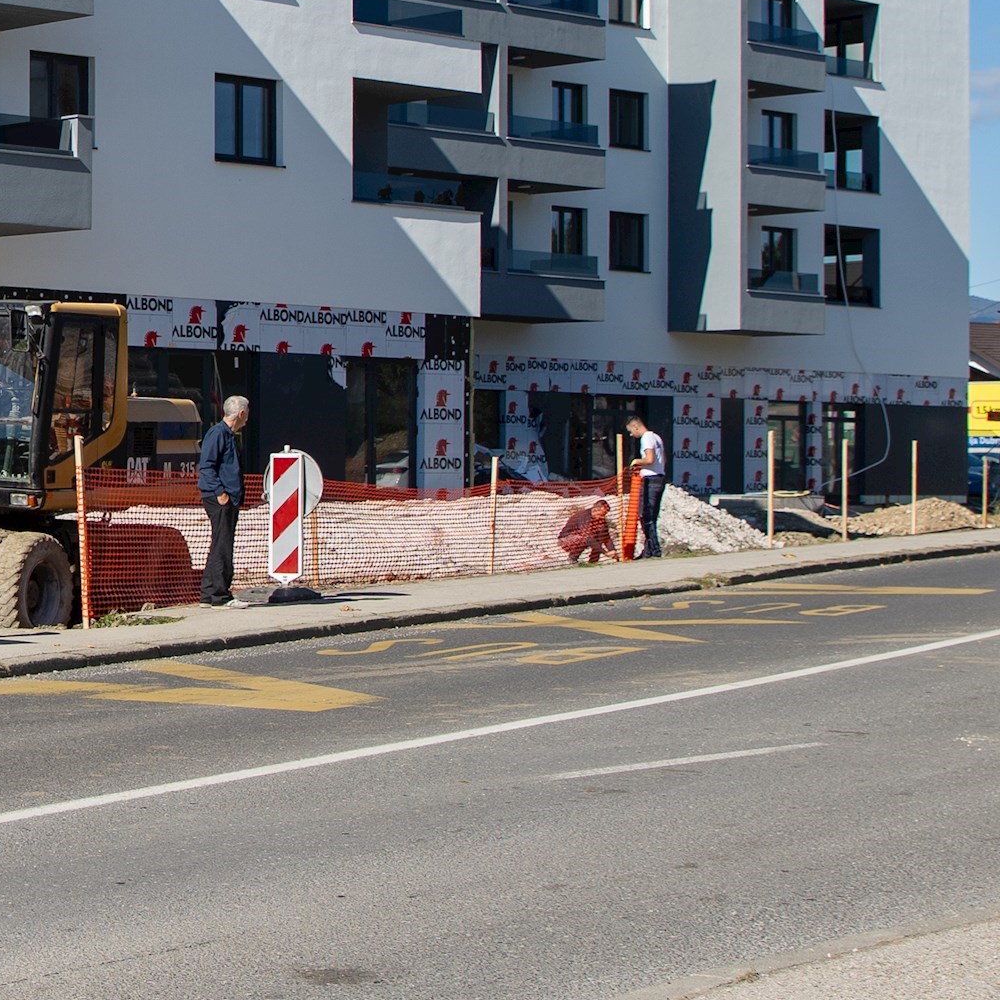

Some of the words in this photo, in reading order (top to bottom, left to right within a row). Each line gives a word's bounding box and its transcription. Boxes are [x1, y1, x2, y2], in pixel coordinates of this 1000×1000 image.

[126, 297, 173, 312] ALBOND
[260, 309, 304, 323] ALBOND
[302, 311, 346, 325] ALBOND
[345, 310, 387, 323] ALBOND
[171, 325, 218, 339] ALBOND
[385, 325, 426, 338] ALBOND
[596, 373, 624, 383] ALBOND
[622, 381, 649, 391] ALBOND
[420, 408, 462, 420] ALBOND
[420, 457, 462, 470] ALBOND
[126, 457, 149, 484] CAT
[163, 462, 172, 478] M
